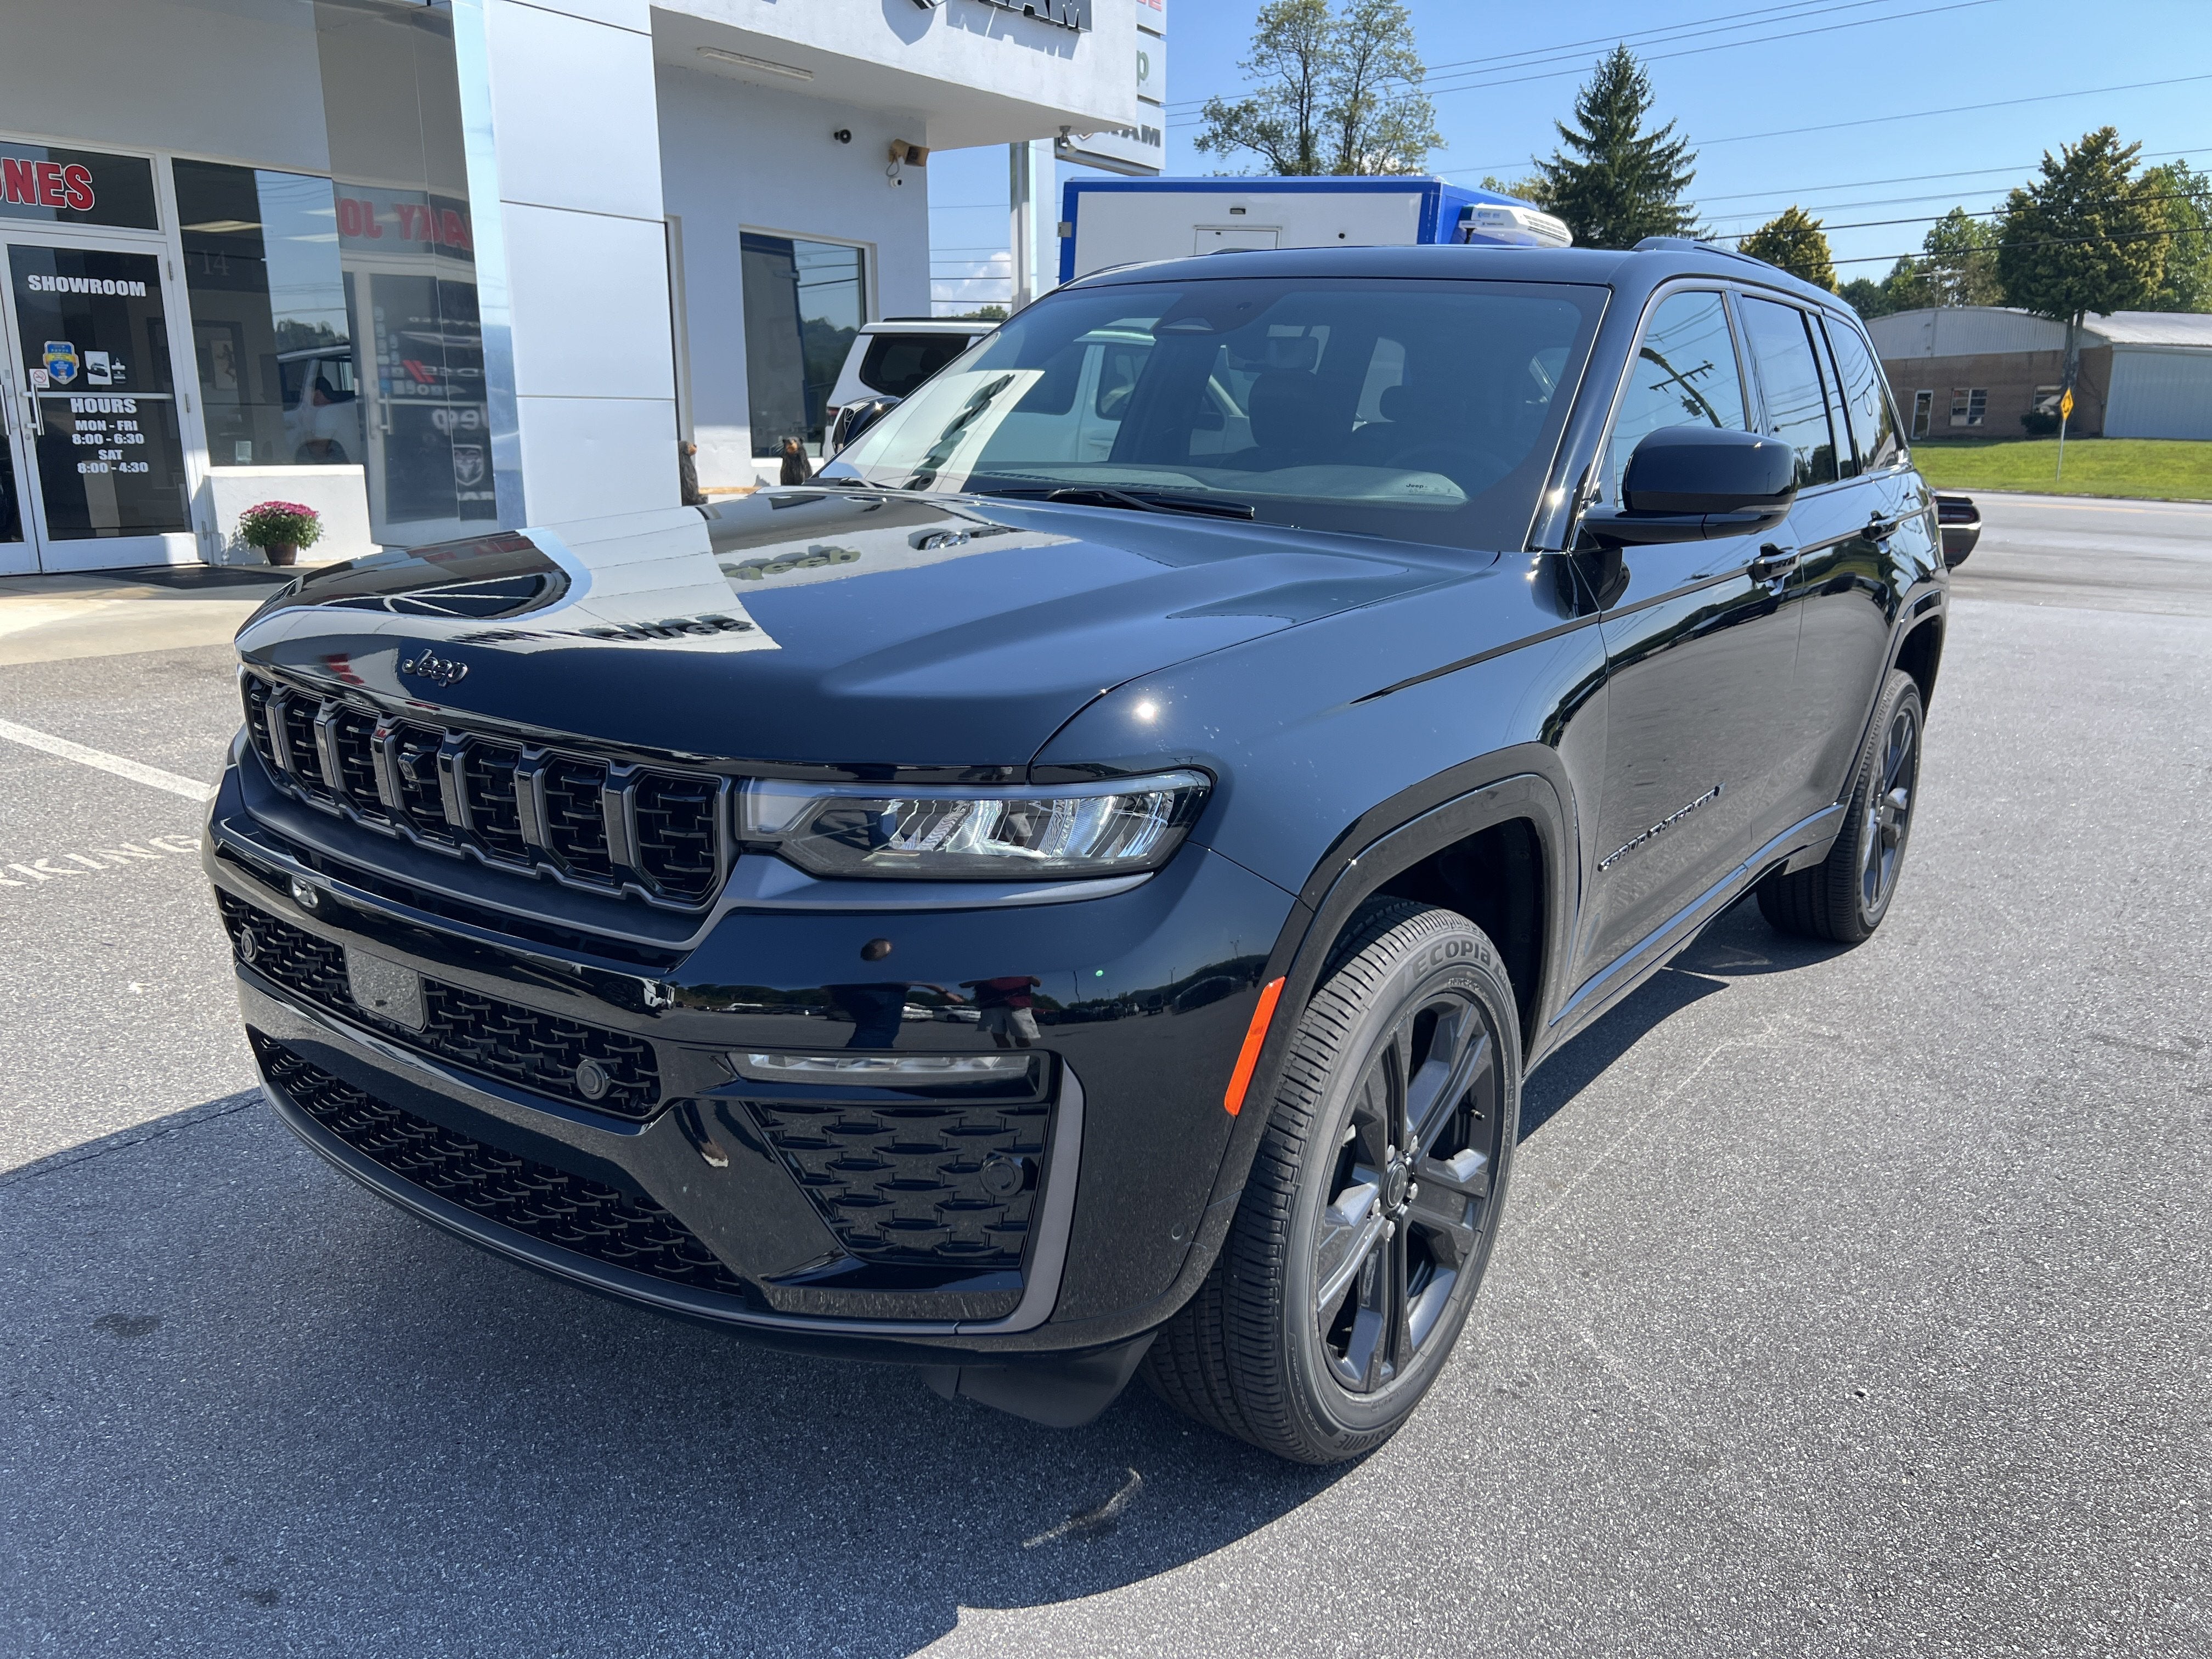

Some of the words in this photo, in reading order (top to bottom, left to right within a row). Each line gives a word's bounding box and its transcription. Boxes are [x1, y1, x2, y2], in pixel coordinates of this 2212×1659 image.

[0, 157, 95, 211] NES
[28, 274, 146, 297] SHOWROOM
[70, 398, 137, 413] HOURS
[75, 420, 106, 431] MON
[116, 420, 138, 431] FRI
[72, 433, 104, 444] 8:00
[114, 433, 144, 444] 6:30
[98, 449, 123, 460] SAT
[77, 462, 108, 473] 8:00
[119, 462, 148, 473] 4:30
[402, 648, 468, 687] Jeep
[0, 834, 202, 886] KING
